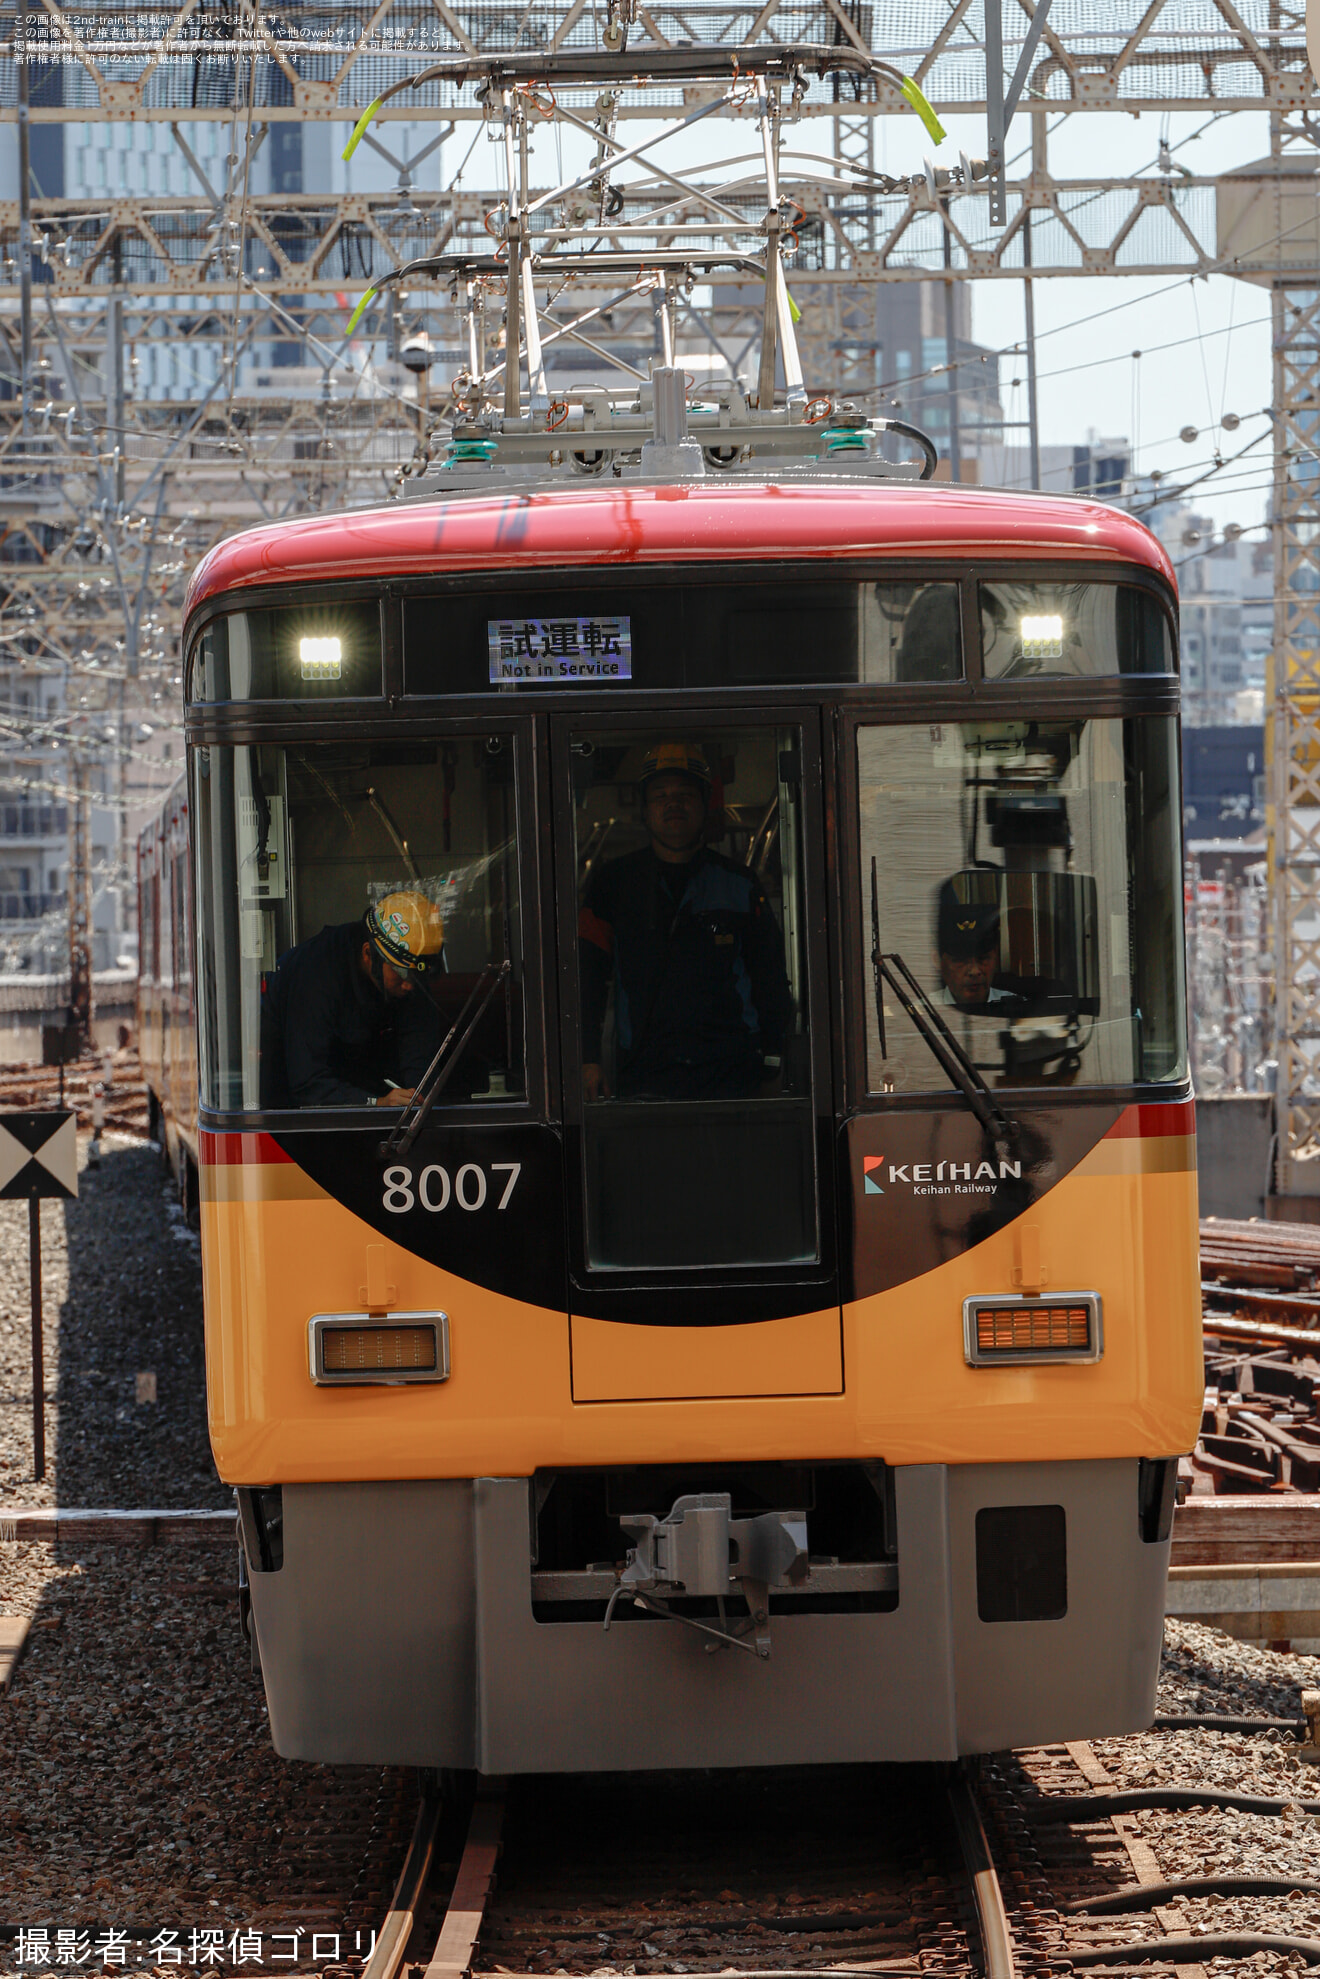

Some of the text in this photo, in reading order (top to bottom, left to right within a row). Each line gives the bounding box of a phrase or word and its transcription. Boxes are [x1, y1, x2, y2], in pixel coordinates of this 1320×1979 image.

[498, 621, 622, 659] 試運転
[502, 661, 619, 677] Not in Service
[888, 1159, 1022, 1183] KEIHAN
[382, 1162, 522, 1214] 8007
[913, 1183, 998, 1195] Keihan Railway
